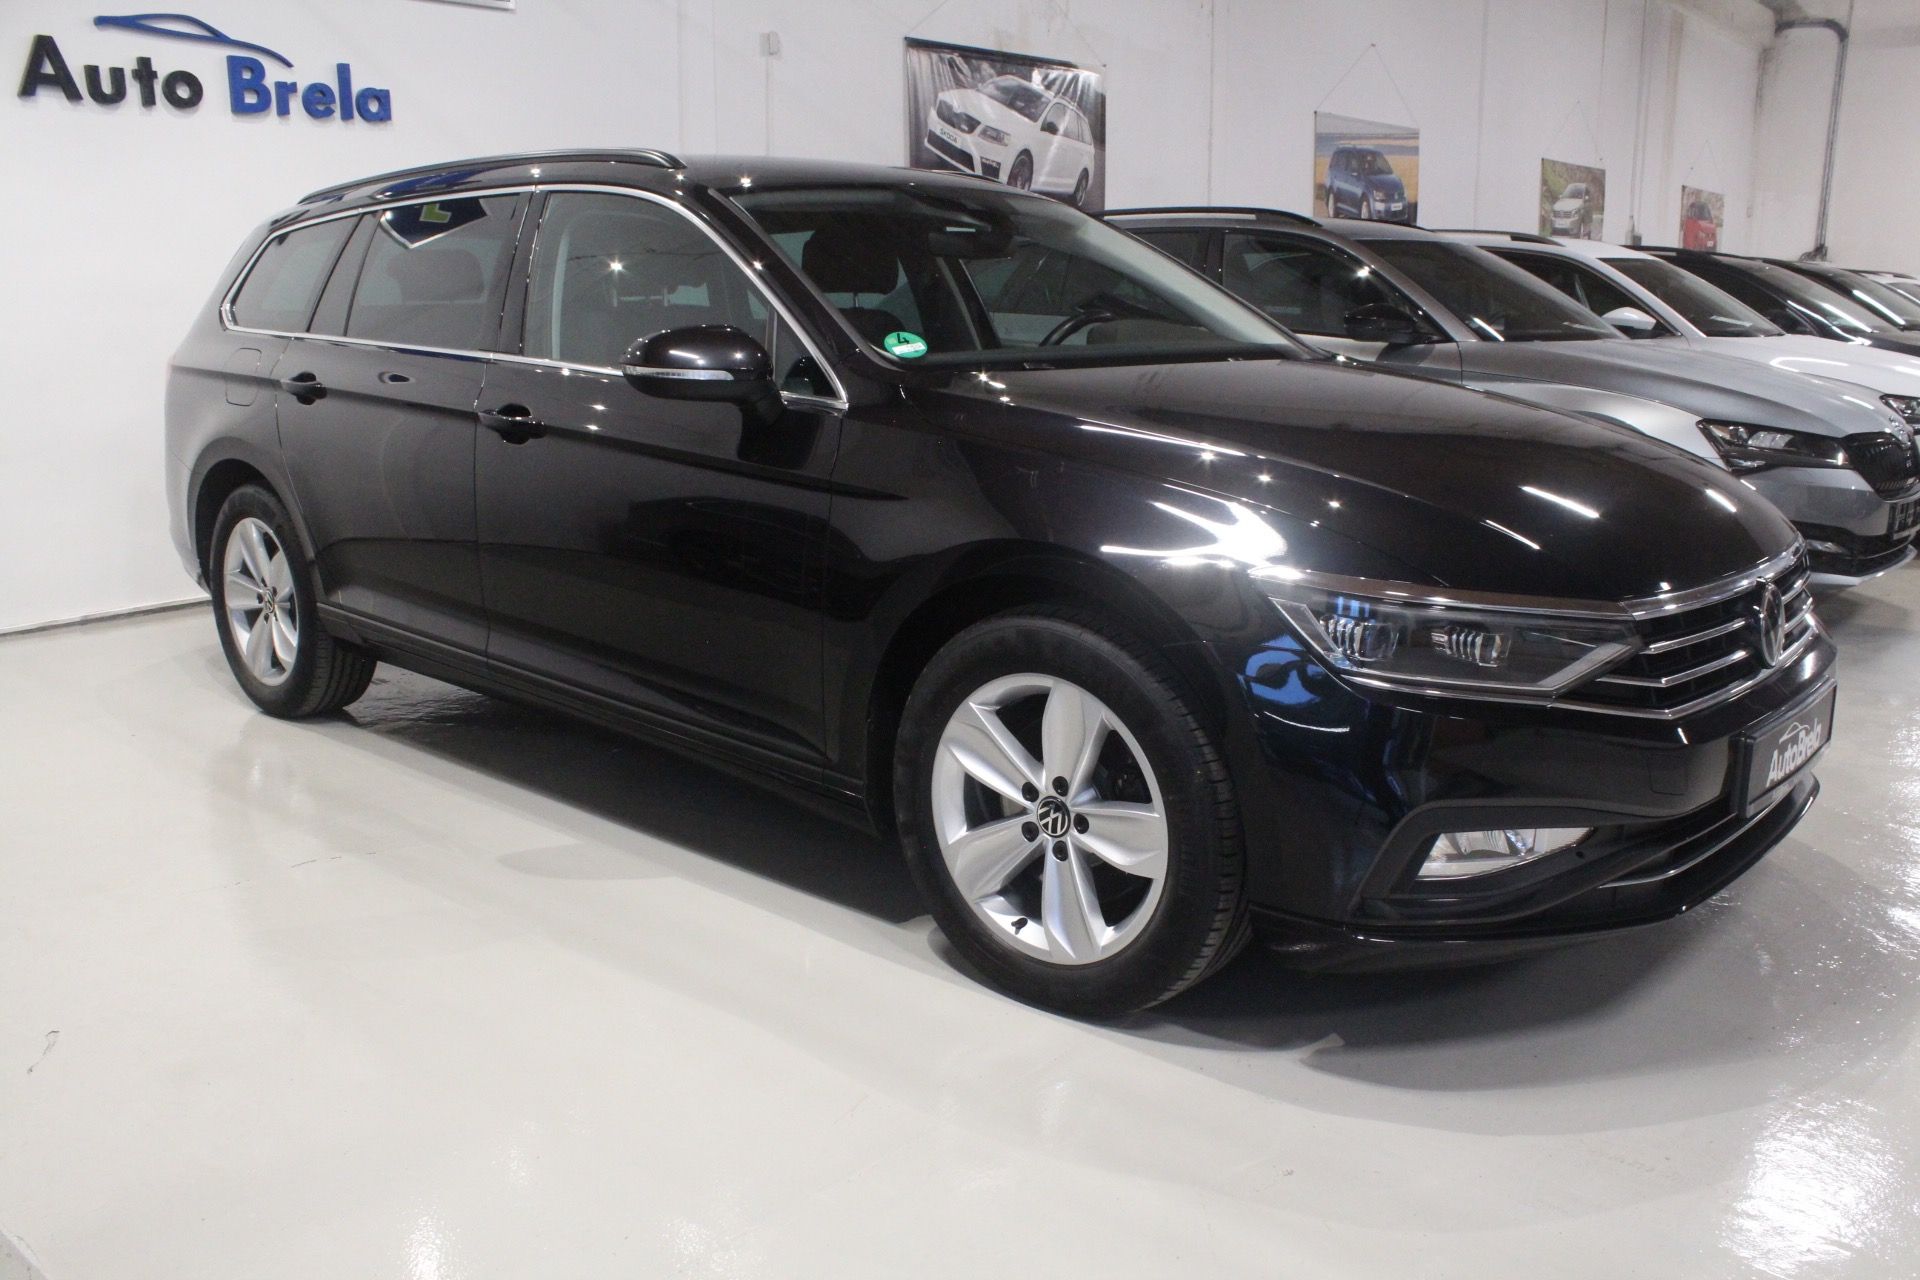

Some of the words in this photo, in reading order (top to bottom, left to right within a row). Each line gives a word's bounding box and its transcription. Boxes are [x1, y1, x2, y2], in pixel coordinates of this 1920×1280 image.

[17, 34, 204, 108] Auto
[226, 54, 392, 122] Brela
[896, 332, 910, 344] 4
